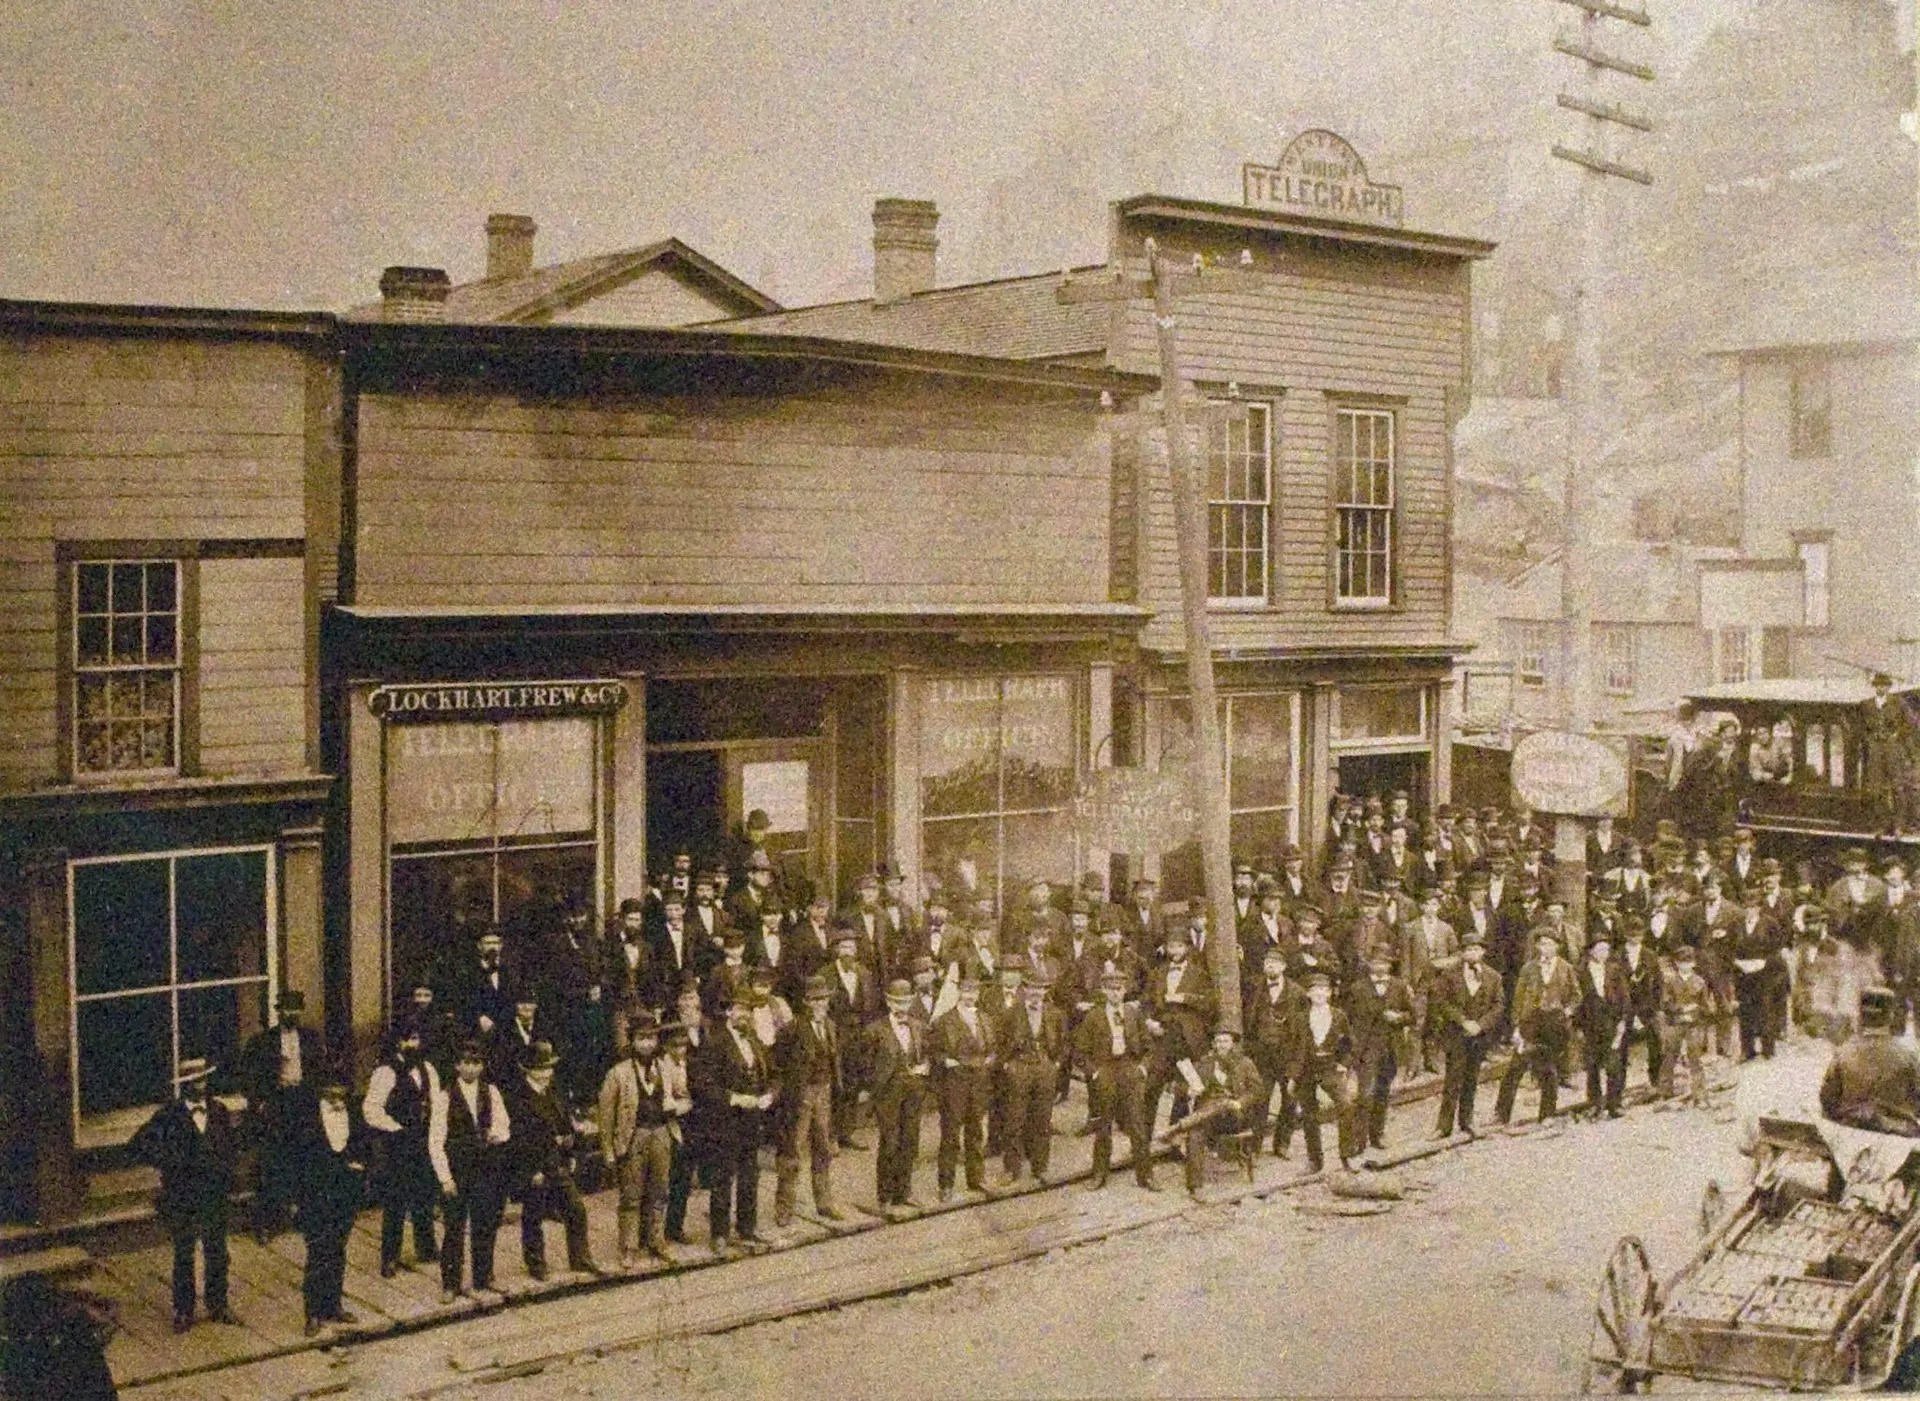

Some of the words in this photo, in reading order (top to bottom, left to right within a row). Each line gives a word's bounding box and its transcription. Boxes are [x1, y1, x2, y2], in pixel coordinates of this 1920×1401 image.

[1249, 170, 1393, 217] TELEGRAPH
[519, 686, 579, 707] FREW
[581, 687, 598, 704] &
